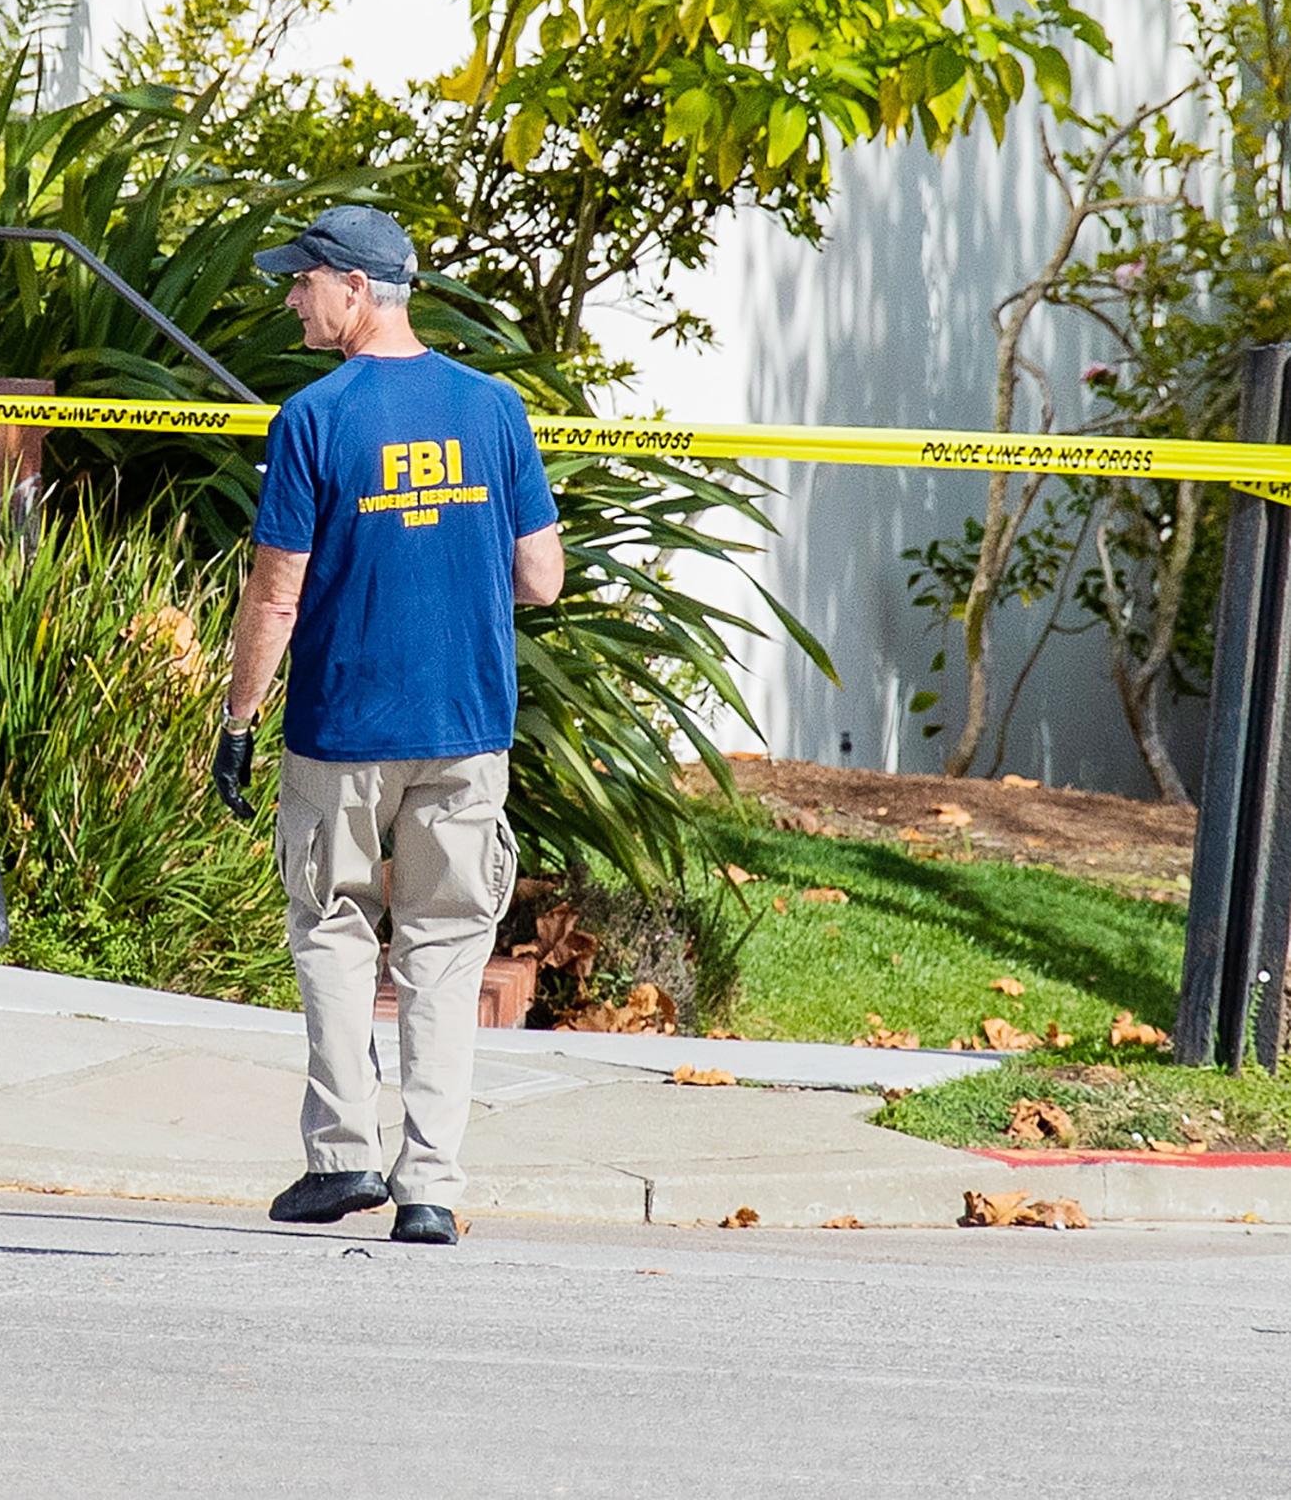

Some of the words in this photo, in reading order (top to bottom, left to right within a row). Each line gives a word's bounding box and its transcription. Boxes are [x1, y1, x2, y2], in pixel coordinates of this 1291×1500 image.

[533, 426, 565, 444] INE
[567, 428, 592, 446] DO
[595, 430, 635, 448] NOT
[635, 431, 695, 450] CROSS
[382, 439, 463, 491] FBI
[921, 442, 983, 463] POLICE
[986, 444, 1025, 465] LINE
[1028, 447, 1054, 467] DO
[1057, 448, 1094, 469] NOT
[1096, 449, 1154, 472] CROSS
[419, 486, 489, 506] RESPONSE
[402, 507, 439, 528] TEAM
